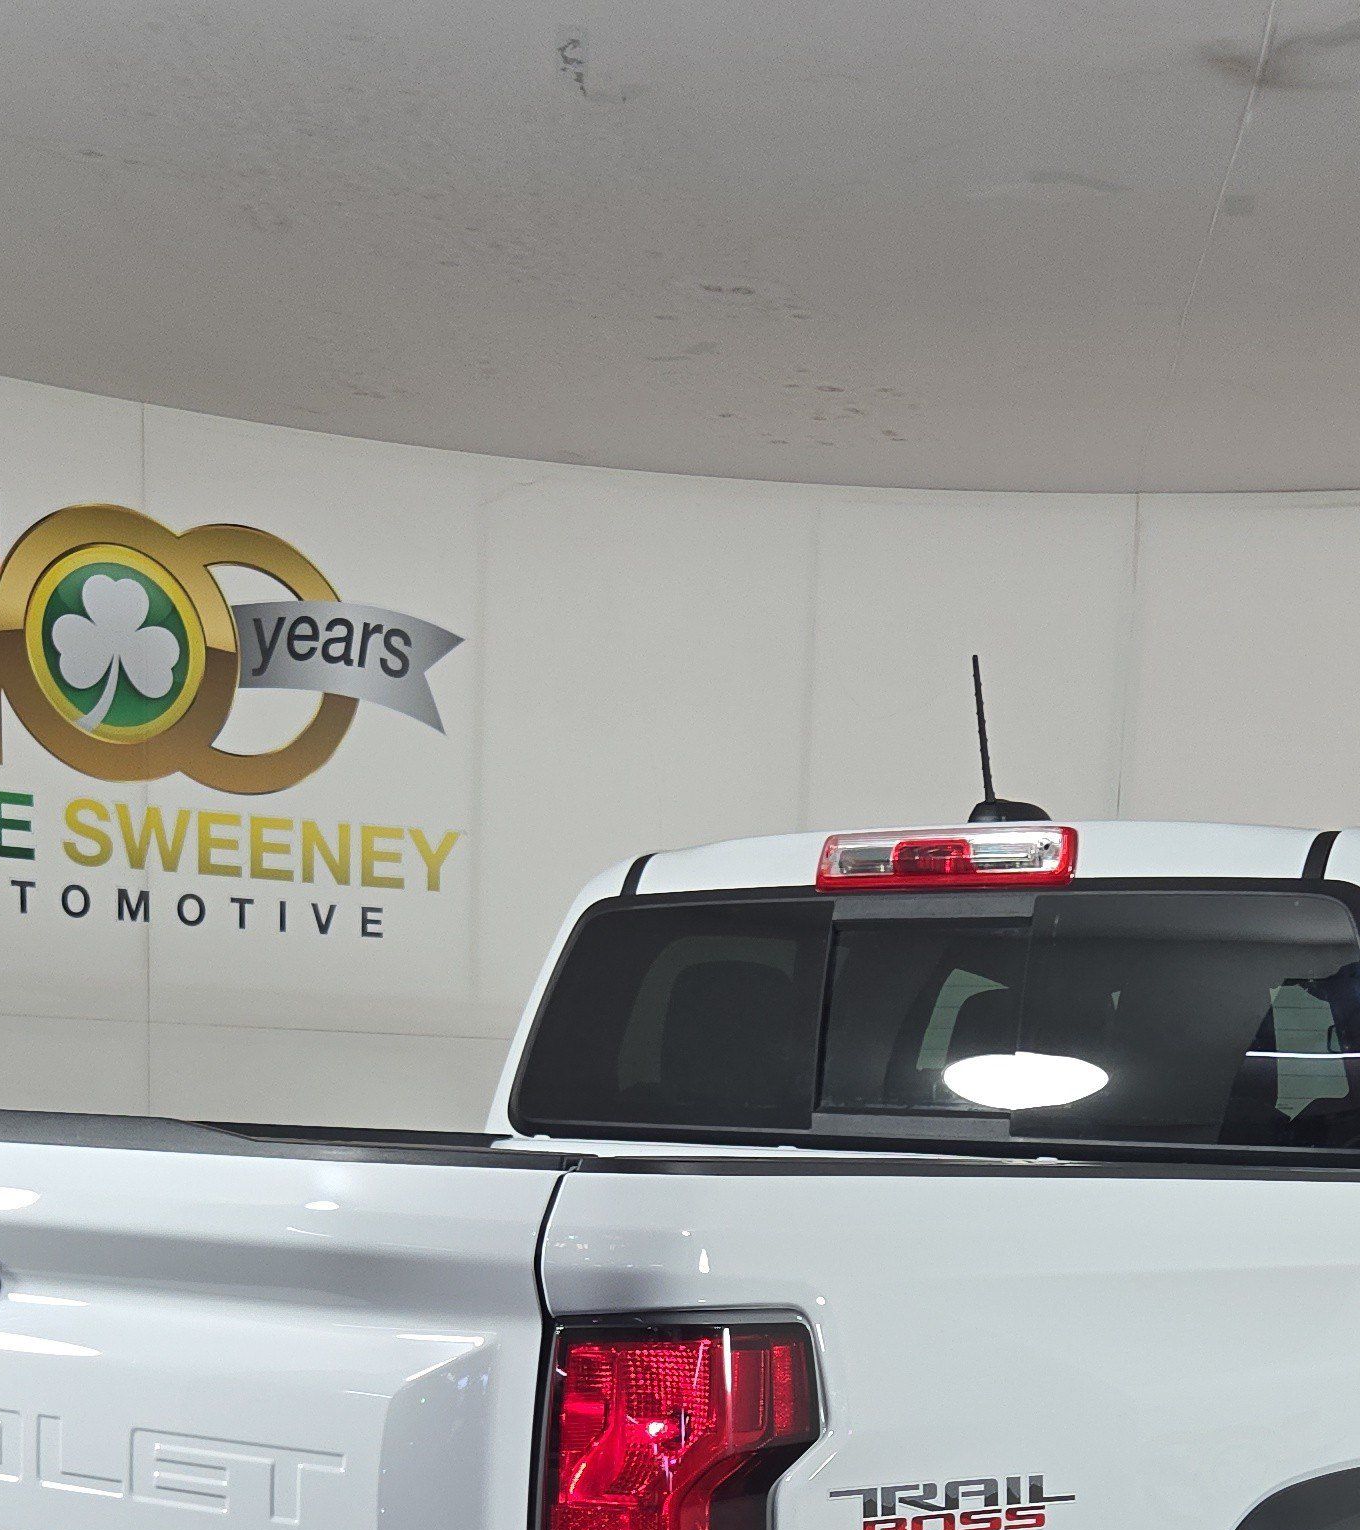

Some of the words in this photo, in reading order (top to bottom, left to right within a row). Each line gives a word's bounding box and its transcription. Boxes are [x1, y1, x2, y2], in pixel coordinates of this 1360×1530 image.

[251, 613, 413, 679] years
[62, 798, 460, 893] SWEENEY
[829, 1473, 1075, 1518] TRAIL
